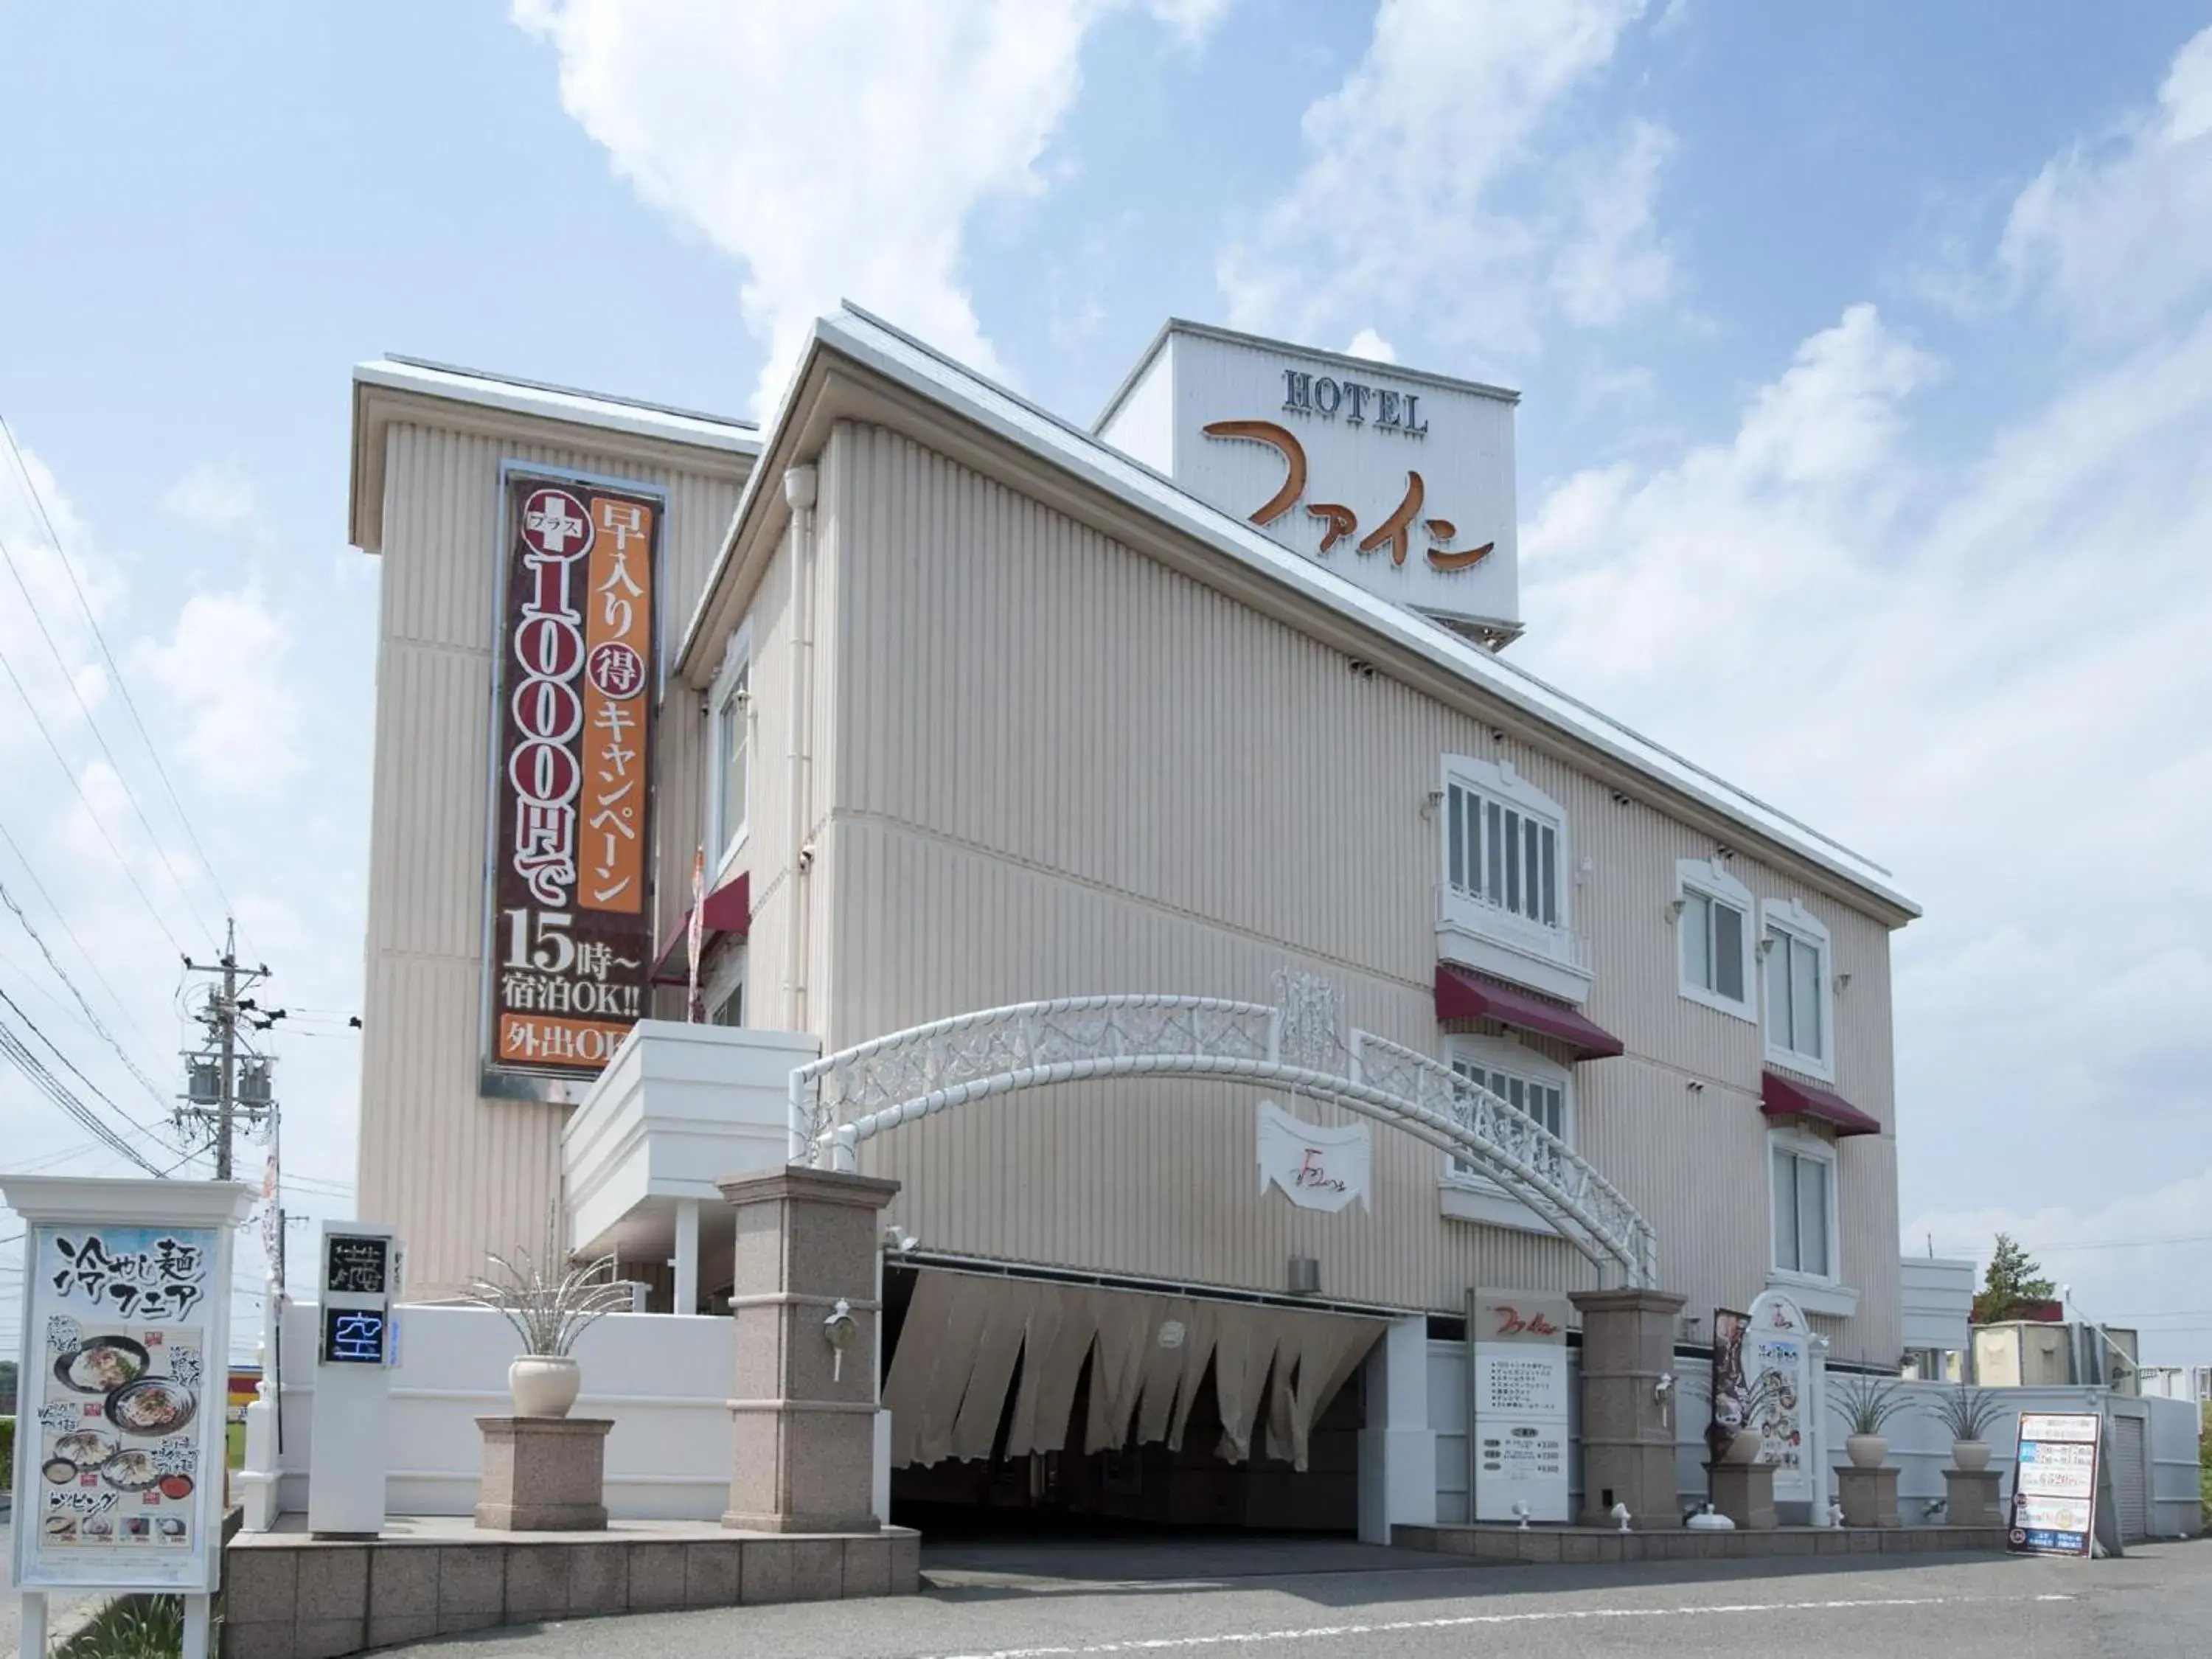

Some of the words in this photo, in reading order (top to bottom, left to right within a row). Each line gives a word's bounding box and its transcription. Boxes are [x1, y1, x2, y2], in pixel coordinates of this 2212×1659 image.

[1283, 369, 1428, 434] HOTEL
[1203, 420, 1495, 571] ファイン
[529, 515, 578, 534] プラス
[501, 973, 640, 1017] 宿泊OK!!
[53, 1237, 198, 1295] 冷やし麺
[108, 1284, 198, 1312] フェア
[333, 1312, 382, 1357] 空
